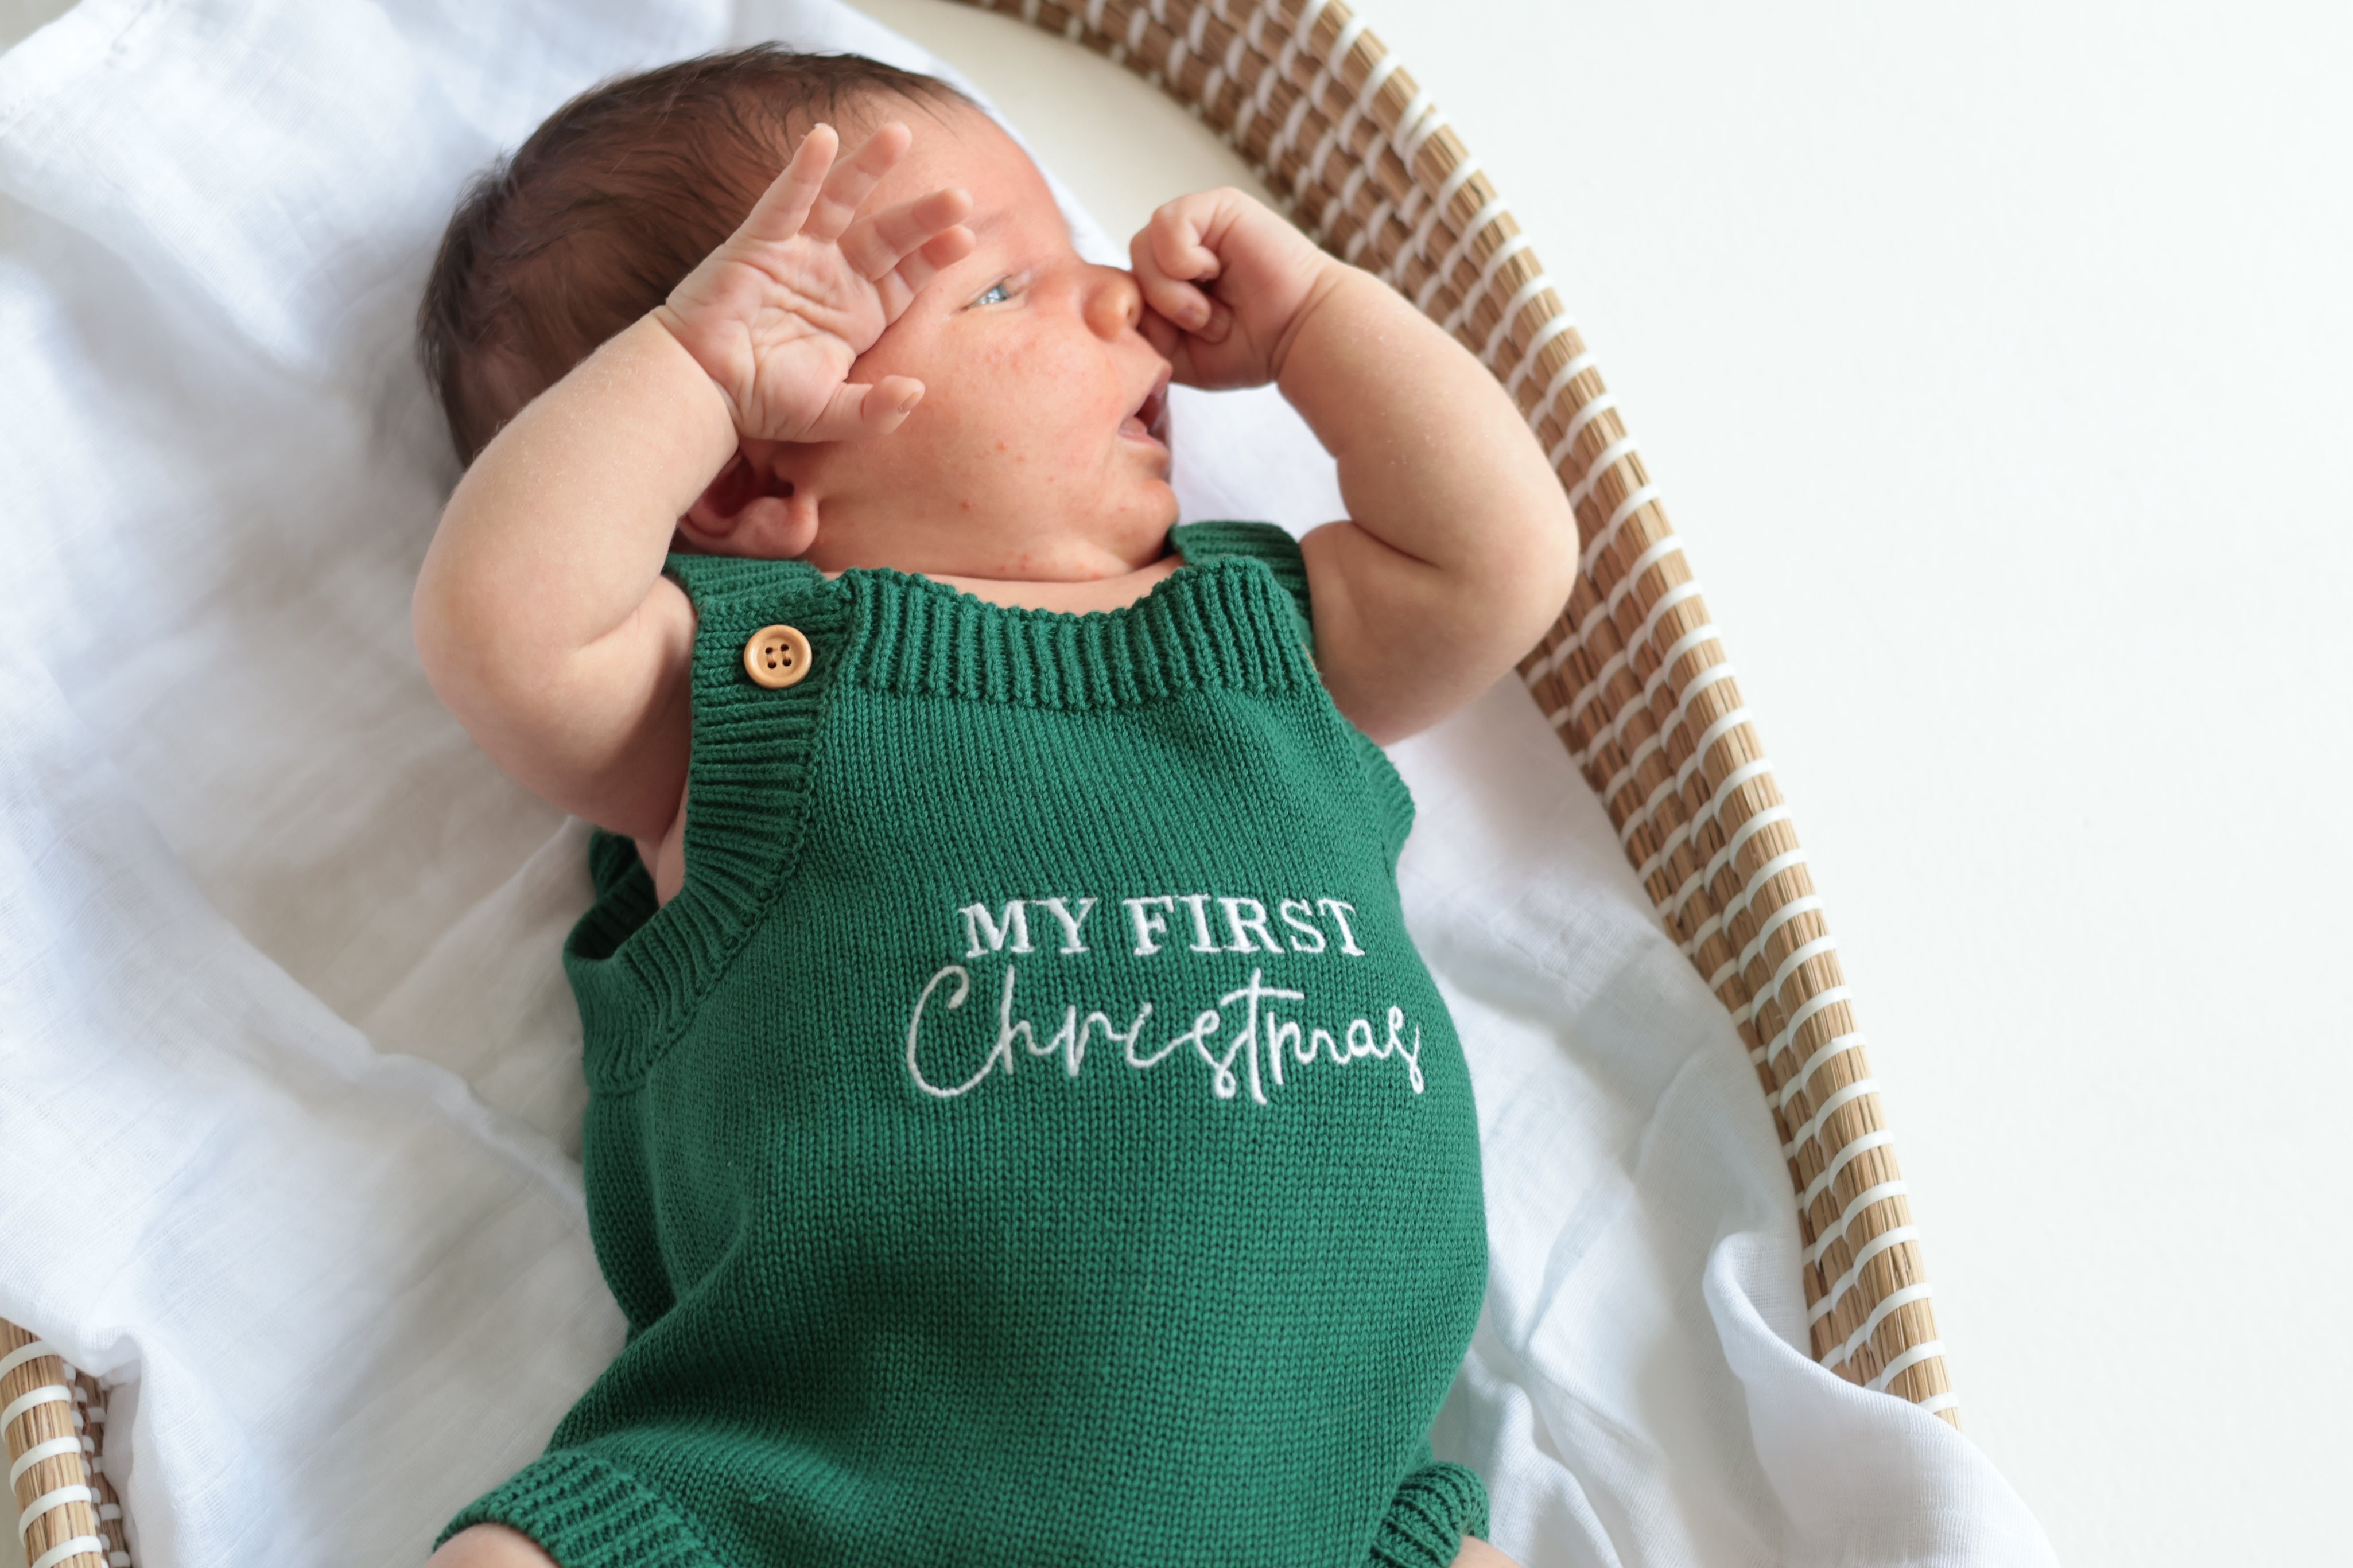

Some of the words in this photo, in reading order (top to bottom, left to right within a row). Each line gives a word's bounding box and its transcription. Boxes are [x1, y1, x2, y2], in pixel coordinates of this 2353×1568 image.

[959, 896, 1097, 958] MY
[1123, 893, 1365, 957] FIRST
[907, 964, 1424, 1105] Christmas
